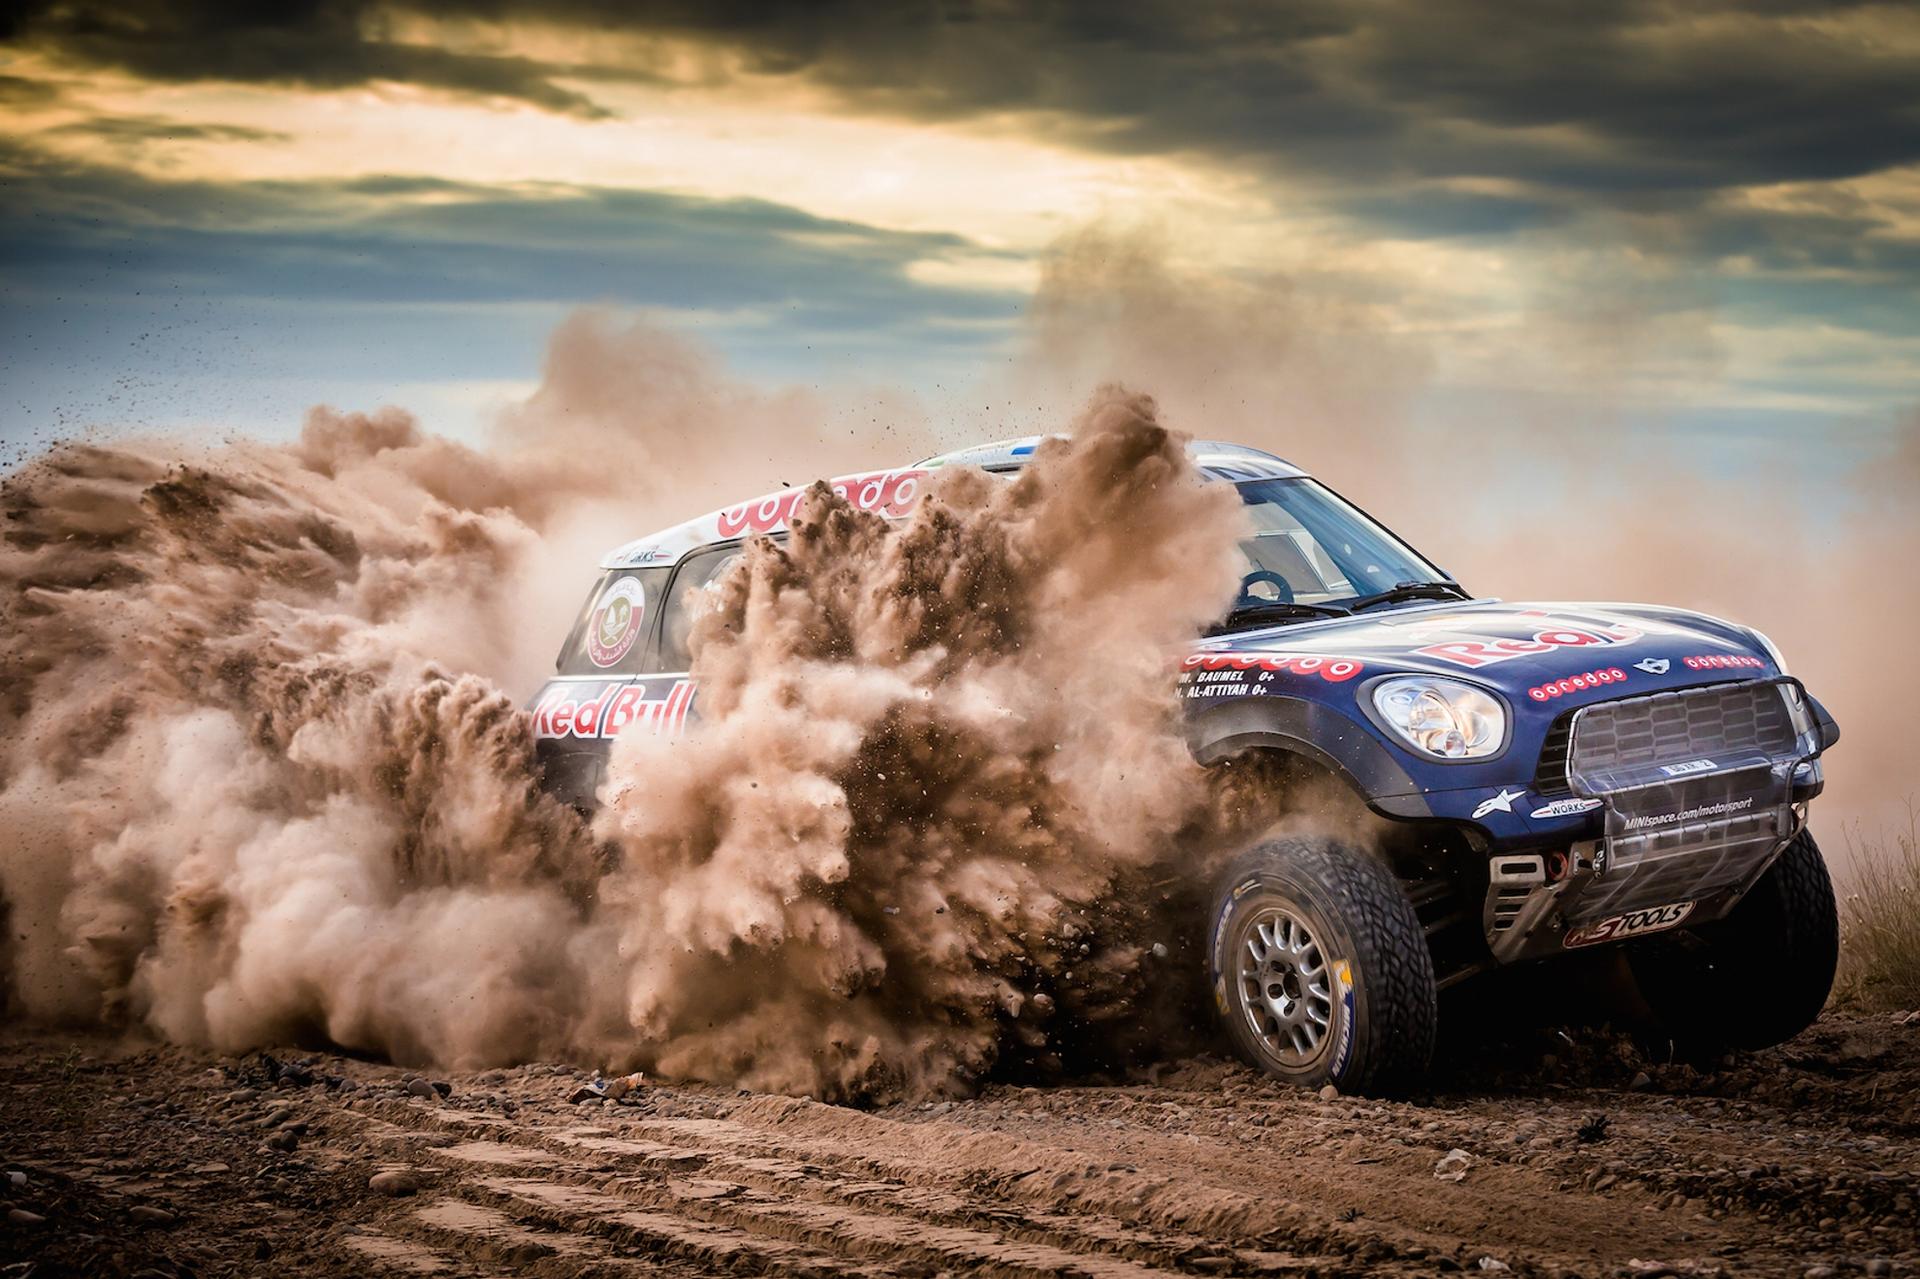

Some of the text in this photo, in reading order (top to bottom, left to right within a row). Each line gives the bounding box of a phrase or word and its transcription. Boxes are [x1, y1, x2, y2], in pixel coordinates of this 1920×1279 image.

[1688, 655, 1761, 669] ooredoo
[1197, 671, 1244, 683] BAUMEL
[1532, 669, 1623, 699] ooredoo
[1187, 684, 1249, 698] AL-ATTIYAH
[532, 684, 621, 737] Red
[1551, 803, 1585, 814] WORKS
[1624, 797, 1752, 830] MINIspace.com/motorsport
[1619, 904, 1685, 932] TOOLS
